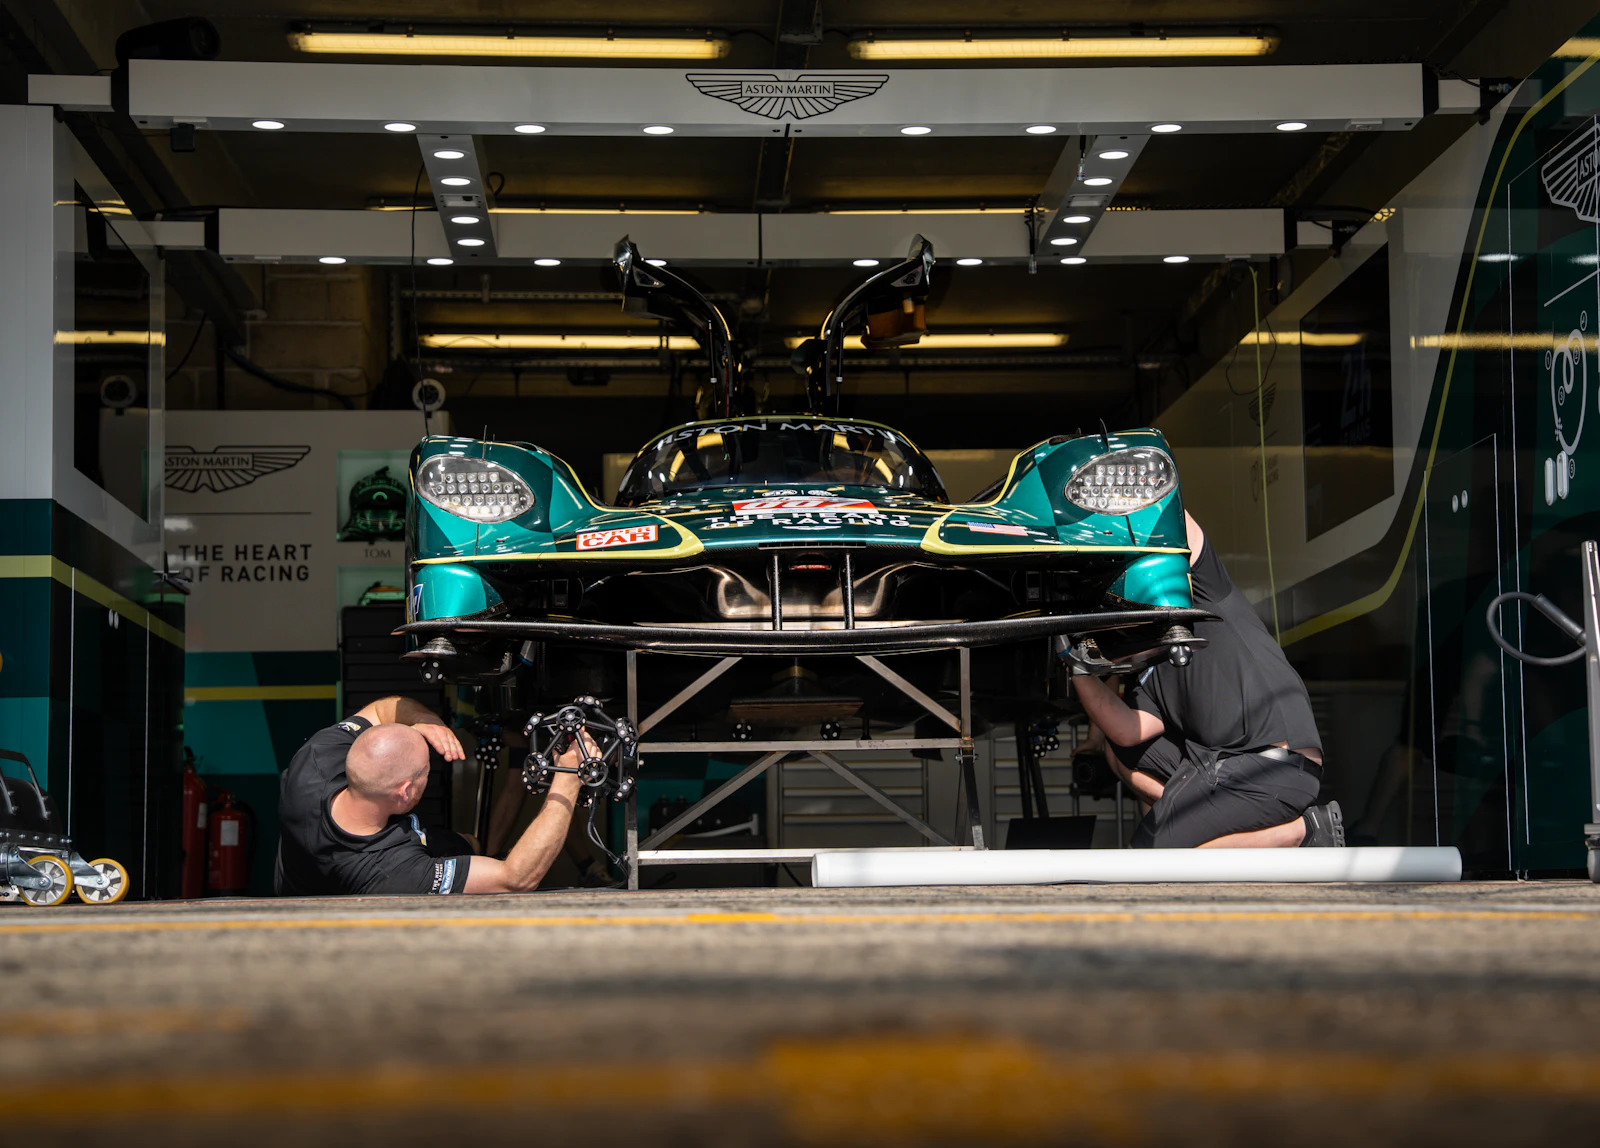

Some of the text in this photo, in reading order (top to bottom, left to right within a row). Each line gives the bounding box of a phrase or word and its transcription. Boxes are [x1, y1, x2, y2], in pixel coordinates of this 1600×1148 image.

[744, 84, 831, 94] ASTON MARTIN
[653, 421, 914, 450] ASTON MARTIN
[203, 456, 250, 467] MARTIN
[705, 512, 911, 522] THE HEART
[710, 517, 911, 528] OF RACING
[583, 527, 650, 539] HYPER
[583, 532, 650, 546] CAR
[178, 544, 312, 561] THE HEART
[364, 548, 391, 558] TOM
[221, 565, 310, 582] RACING
